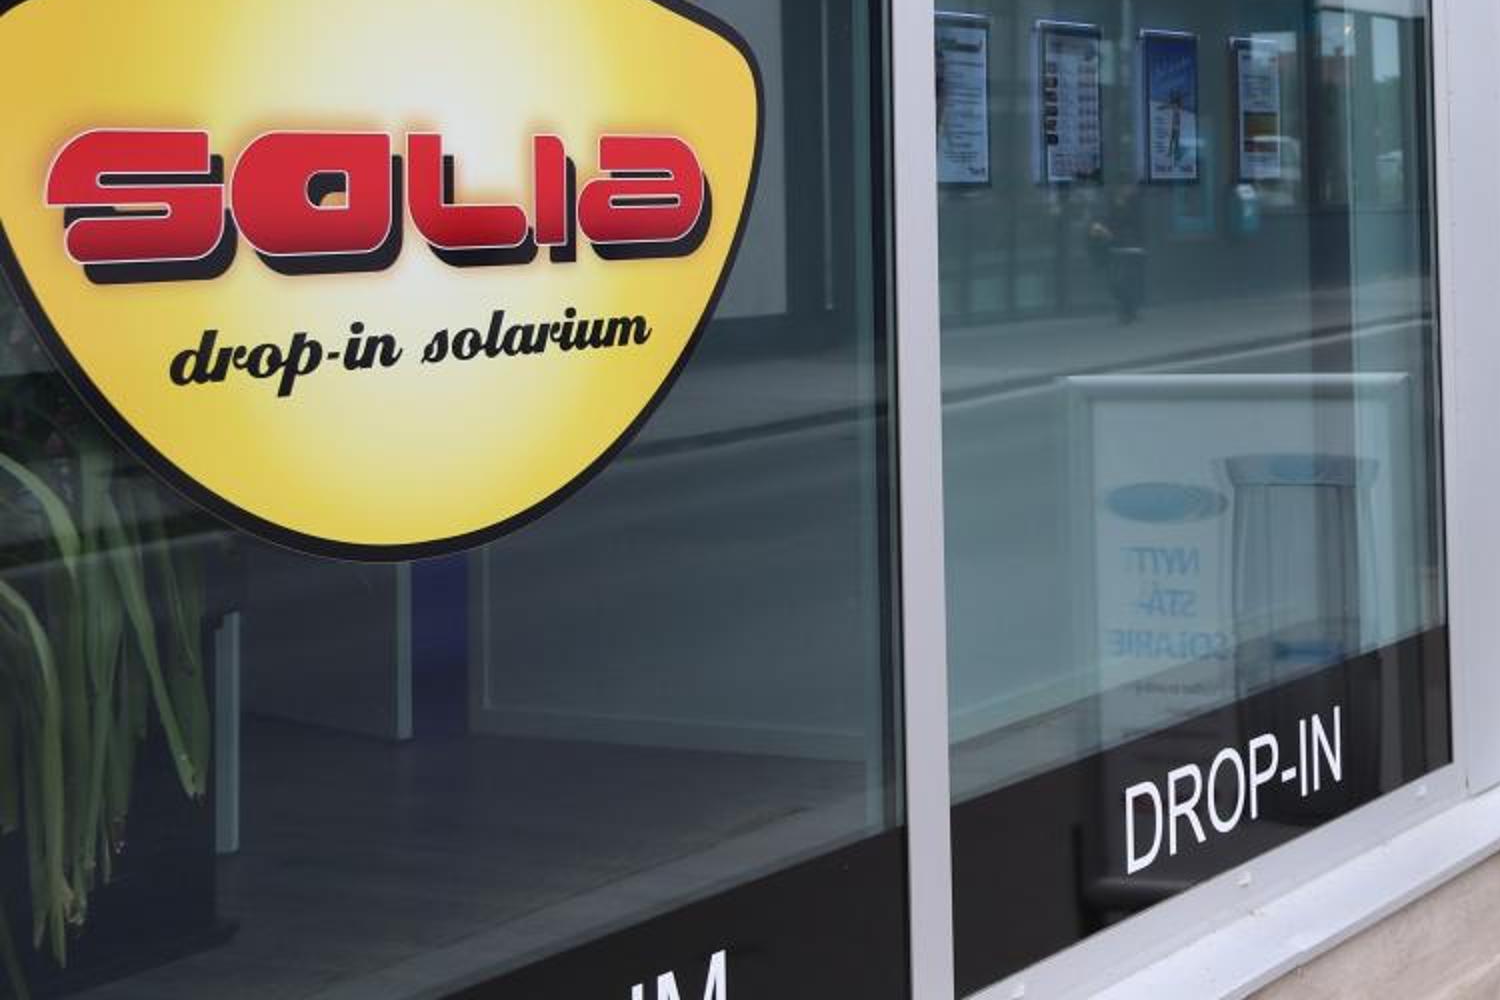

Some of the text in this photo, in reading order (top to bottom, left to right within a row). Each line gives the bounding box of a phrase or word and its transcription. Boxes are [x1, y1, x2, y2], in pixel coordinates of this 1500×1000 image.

[169, 306, 653, 398] drop-in solarium
[1124, 704, 1343, 876] DROP-IN
